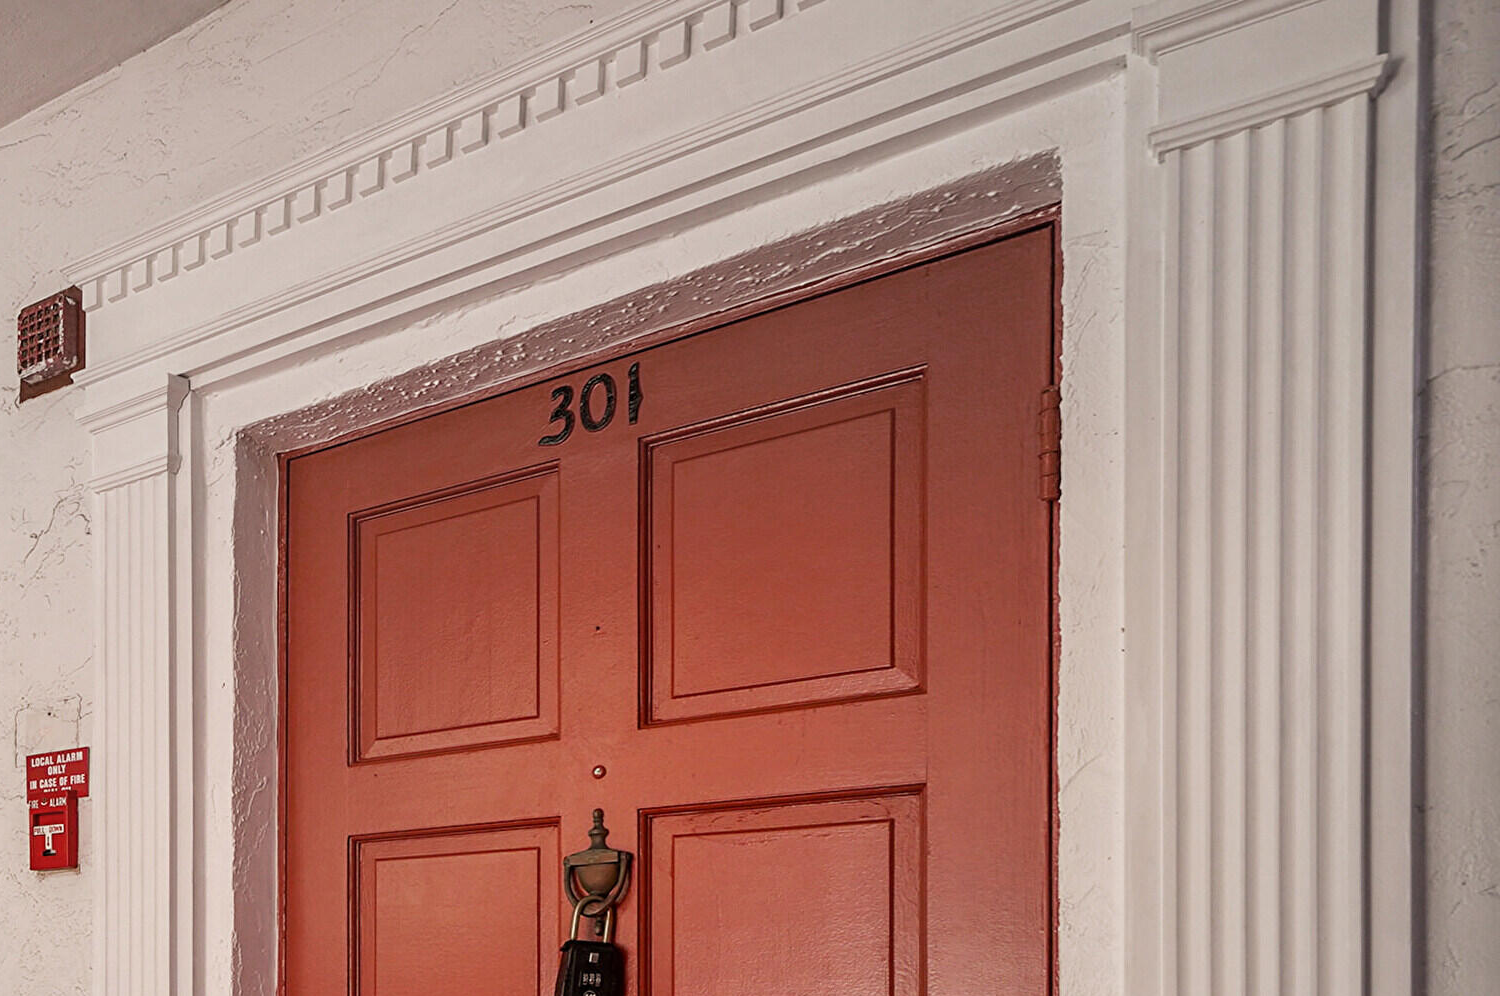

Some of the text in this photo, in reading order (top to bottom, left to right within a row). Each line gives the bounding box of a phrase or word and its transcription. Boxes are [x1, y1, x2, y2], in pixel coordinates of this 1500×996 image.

[538, 362, 644, 446] 301
[31, 751, 83, 768] LOCAL ALARM
[47, 764, 67, 776] ONLY
[29, 780, 38, 790] IN
[39, 777, 57, 789] CASE
[59, 776, 68, 786] OF
[70, 774, 86, 784] FIRE
[49, 797, 67, 807] ALARM
